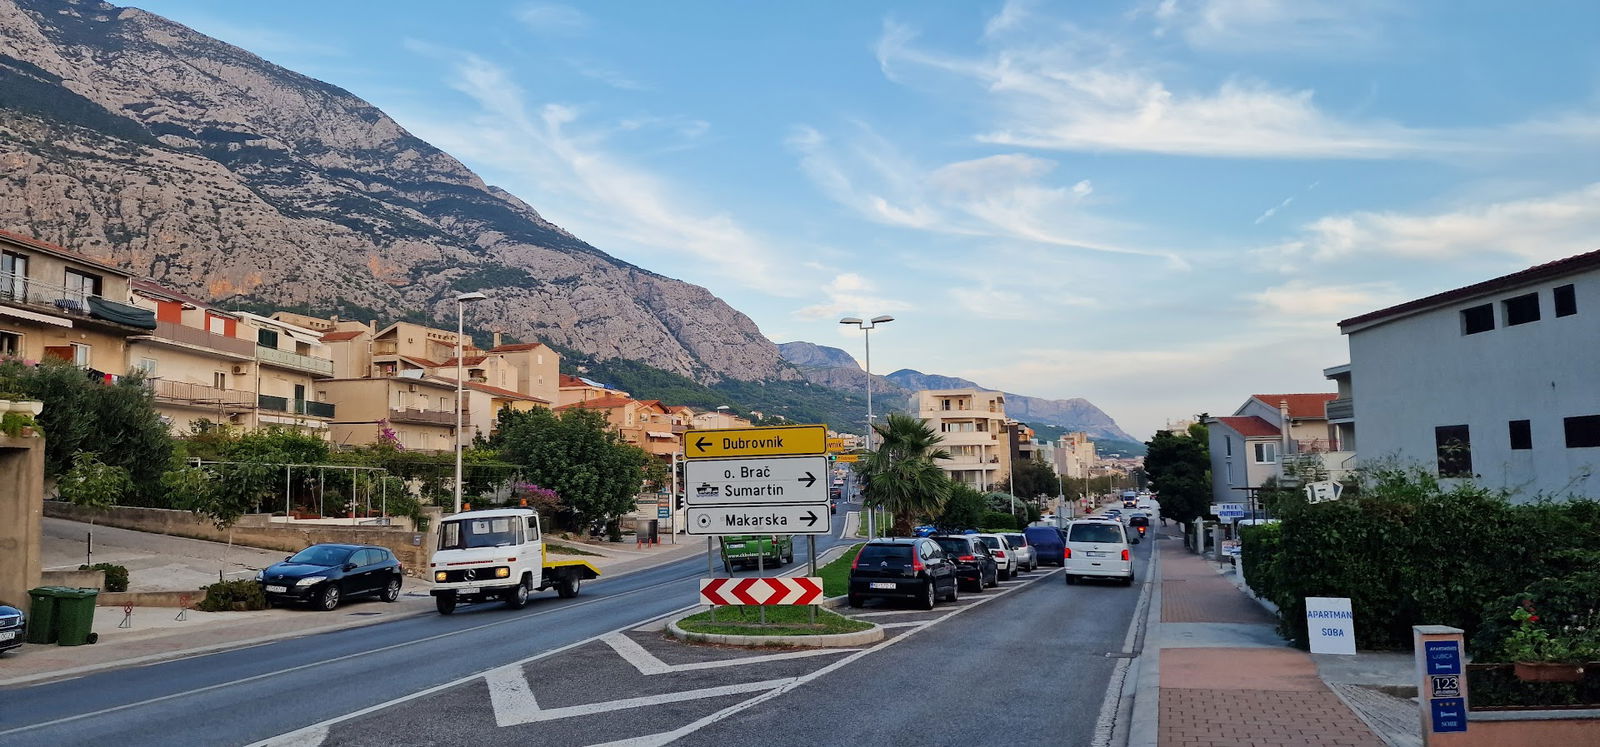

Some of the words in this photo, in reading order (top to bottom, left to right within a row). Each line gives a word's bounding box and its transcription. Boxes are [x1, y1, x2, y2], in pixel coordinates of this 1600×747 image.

[722, 436, 784, 450] Dubrovnik
[724, 469, 735, 479] o.
[740, 466, 771, 478] Brač
[724, 484, 784, 497] Sumartin
[725, 513, 788, 527] Makarska
[1307, 610, 1352, 619] APARTMAN
[1321, 627, 1345, 637] SOBA
[1435, 677, 1458, 690] 123
